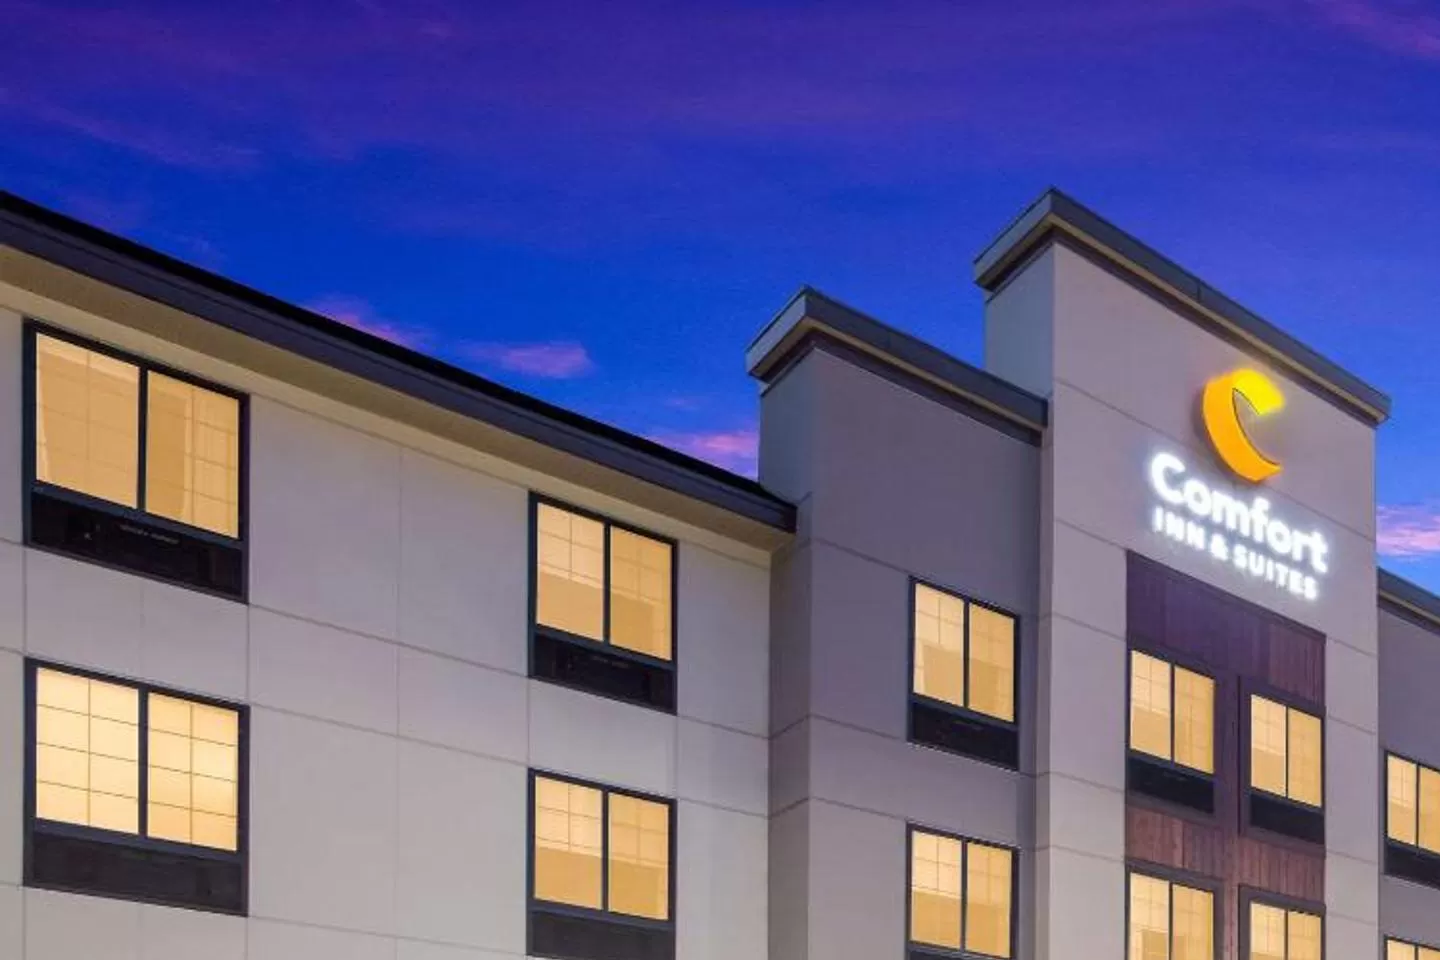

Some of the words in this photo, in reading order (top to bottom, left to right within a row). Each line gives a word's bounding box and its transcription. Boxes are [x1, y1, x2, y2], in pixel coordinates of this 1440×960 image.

[1151, 452, 1328, 574] Comfort
[1153, 506, 1206, 550] INN
[1209, 533, 1229, 561] &
[1233, 544, 1318, 600] SUITES
